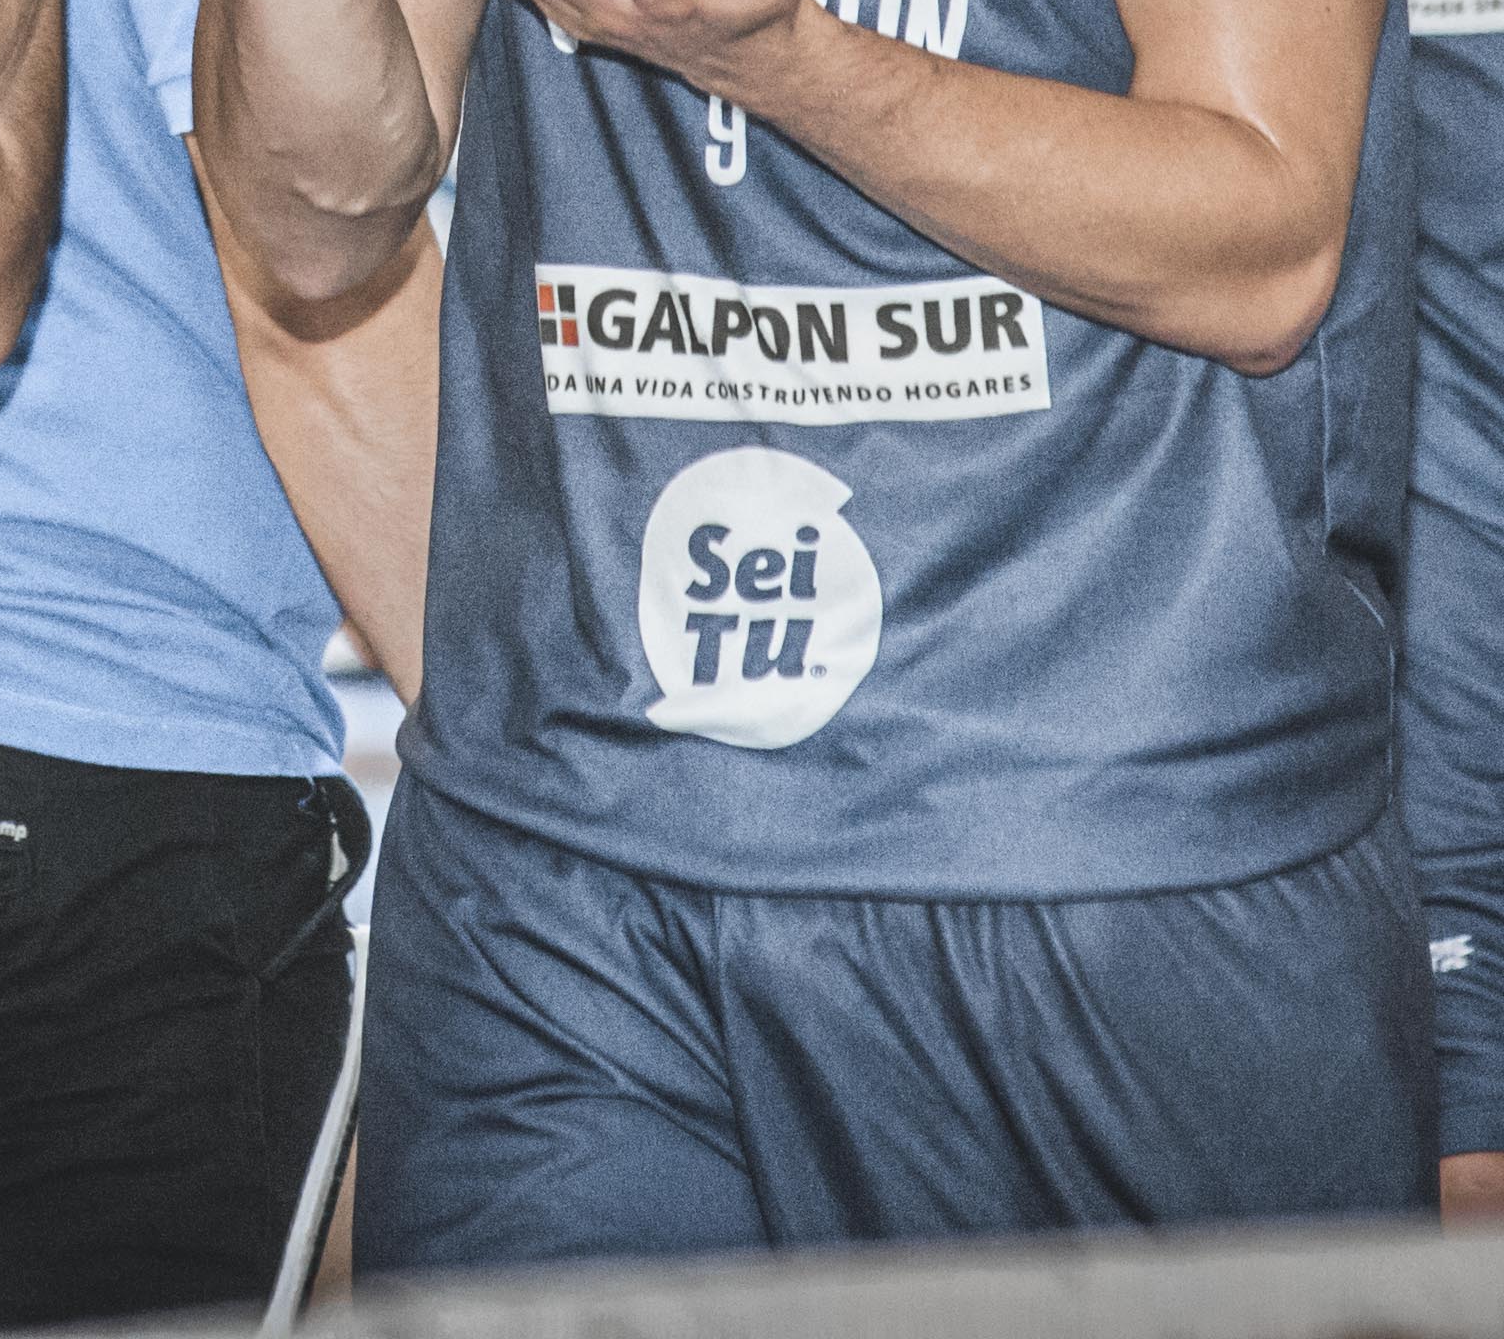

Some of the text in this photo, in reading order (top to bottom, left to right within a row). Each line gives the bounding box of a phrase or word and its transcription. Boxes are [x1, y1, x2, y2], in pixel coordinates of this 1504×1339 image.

[587, 288, 1029, 364] GALPON SUR
[635, 379, 692, 399] VIDA
[705, 381, 892, 404] CONSTRUYENDO
[906, 373, 1032, 401] HOGARES
[684, 523, 821, 603] Sei
